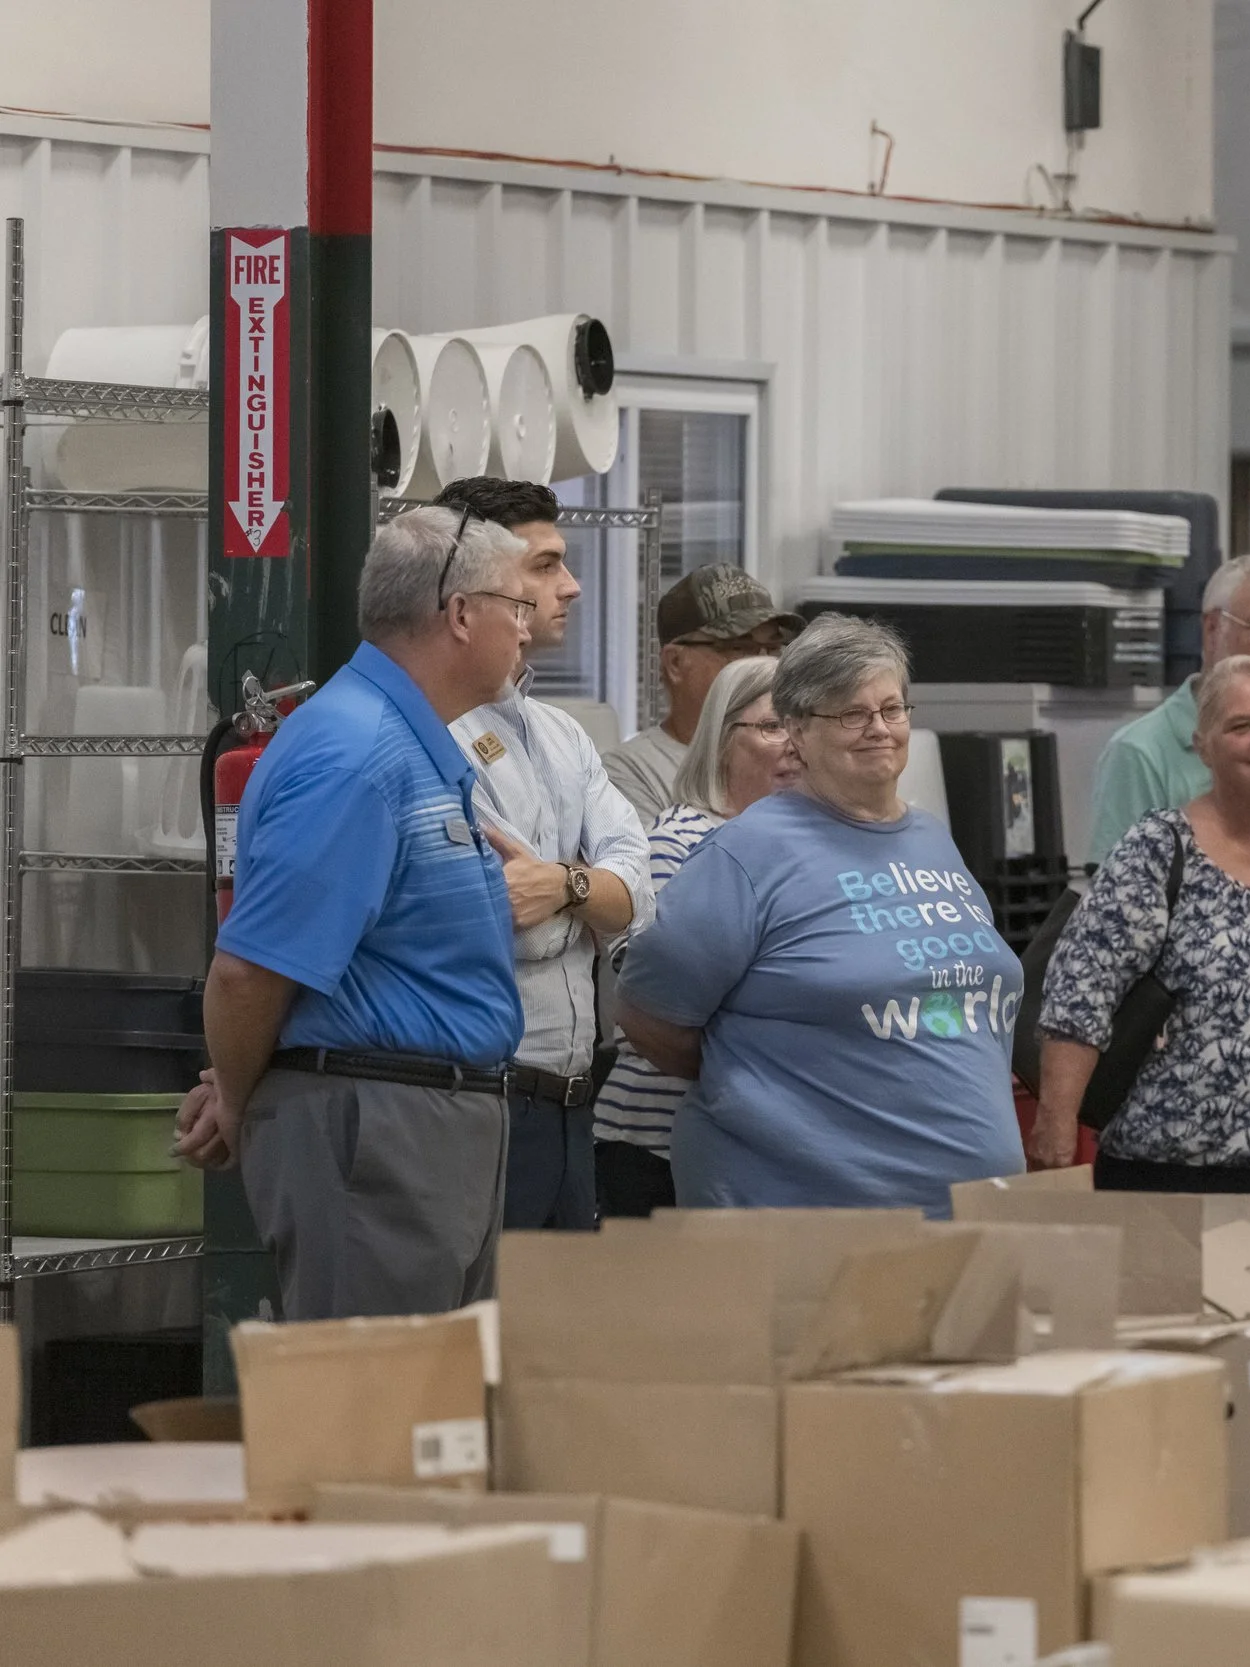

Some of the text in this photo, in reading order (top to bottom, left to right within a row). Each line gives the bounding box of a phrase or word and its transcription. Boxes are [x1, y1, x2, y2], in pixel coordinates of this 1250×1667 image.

[235, 255, 280, 284] FIRE
[247, 298, 266, 526] EXTINGUISHER
[837, 862, 972, 900] Believe
[850, 896, 993, 934] there is
[896, 925, 999, 971] good
[929, 960, 984, 989] in the
